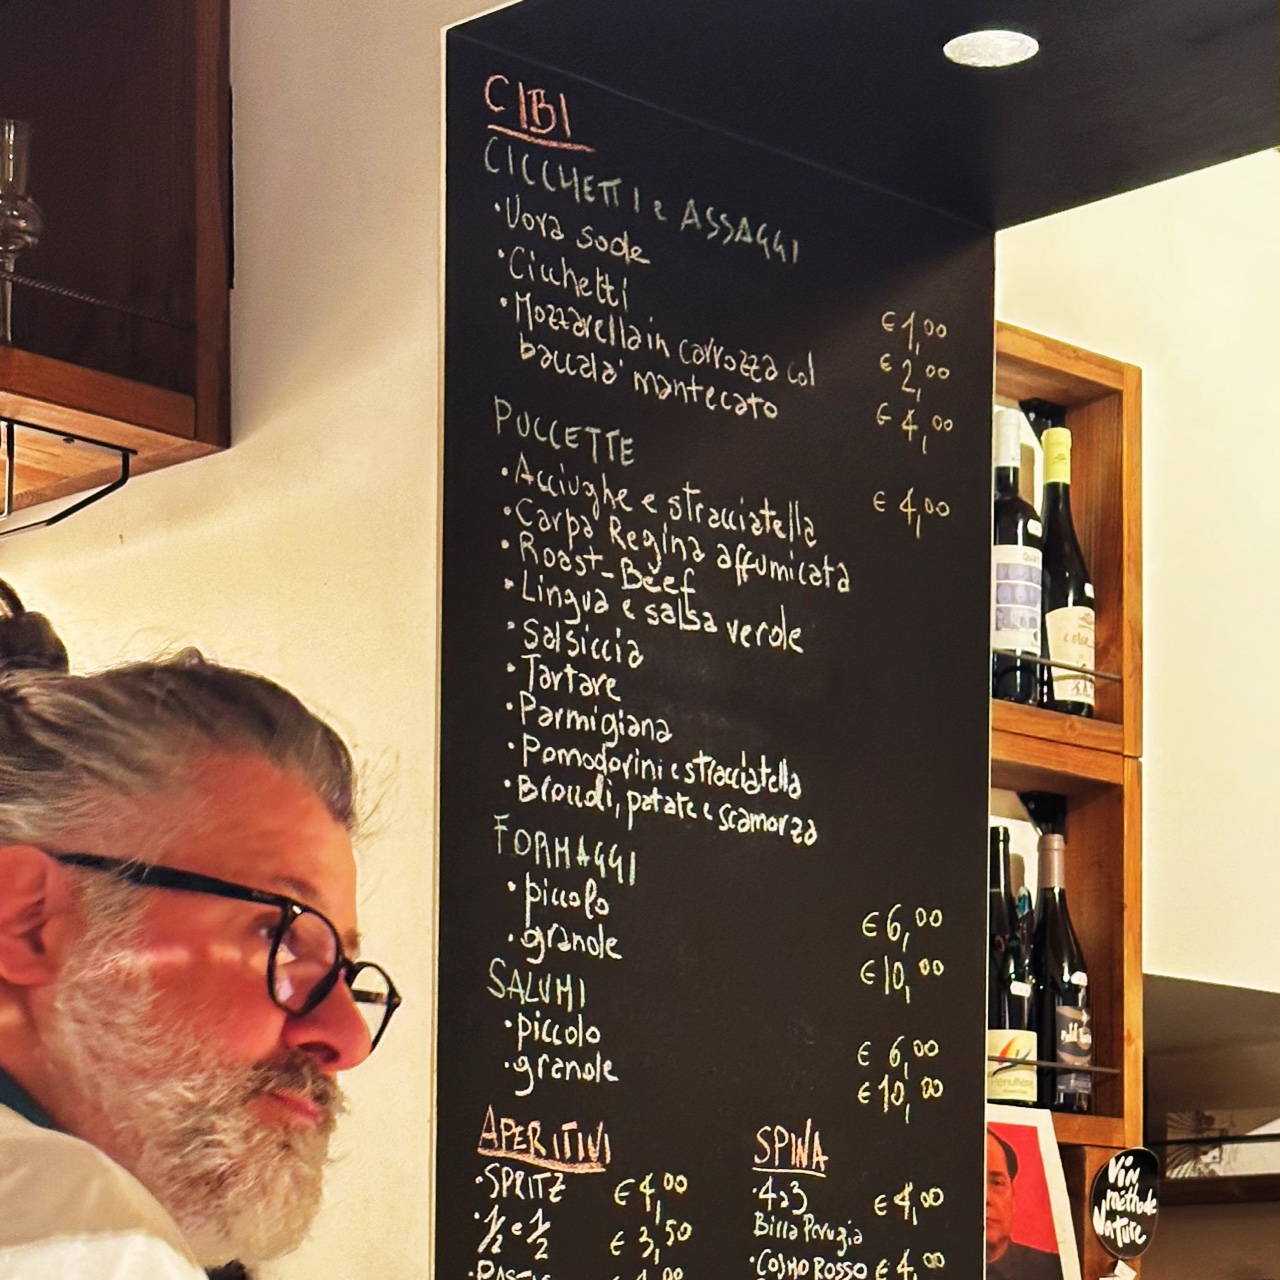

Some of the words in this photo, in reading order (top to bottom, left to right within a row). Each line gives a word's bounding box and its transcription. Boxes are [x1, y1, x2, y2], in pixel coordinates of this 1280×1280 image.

[483, 74, 571, 138] CIBI
[484, 136, 640, 213] CICCHETTI
[680, 199, 800, 263] ASSAGGI
[576, 225, 650, 265] sode
[508, 246, 628, 309] Cicchetti
[678, 337, 778, 383] carrozza
[786, 352, 816, 386] col
[634, 371, 778, 421] mantecato
[493, 394, 635, 466] PUCCETTE
[515, 451, 634, 517] Acciughe
[668, 481, 817, 547] stracciatella
[516, 498, 595, 549] Carpa
[610, 518, 705, 575] Regina
[716, 543, 851, 594] affumicata
[522, 570, 609, 625] Lingua
[645, 599, 718, 632] salsa
[727, 604, 804, 653] verde
[522, 618, 644, 669] Salsiccia
[520, 654, 621, 701] Tartare
[520, 691, 673, 748] Parmigiana
[522, 732, 663, 781] Pomodorini
[684, 750, 802, 799] stracciatella
[627, 788, 698, 831] patate
[718, 802, 818, 846] scamorza
[493, 813, 638, 886] FORMAGGI
[524, 872, 611, 927] piccolo
[520, 923, 622, 965] grande
[486, 957, 585, 1013] SALUMI
[516, 1011, 601, 1051] piccolo
[514, 1052, 620, 1097] grande
[478, 1104, 611, 1165] APERITIVI
[754, 1118, 828, 1171] SPINA
[484, 1163, 567, 1204] SPRITZ
[1105, 1183, 1157, 1216] méthode
[1092, 1199, 1147, 1248] Nature
